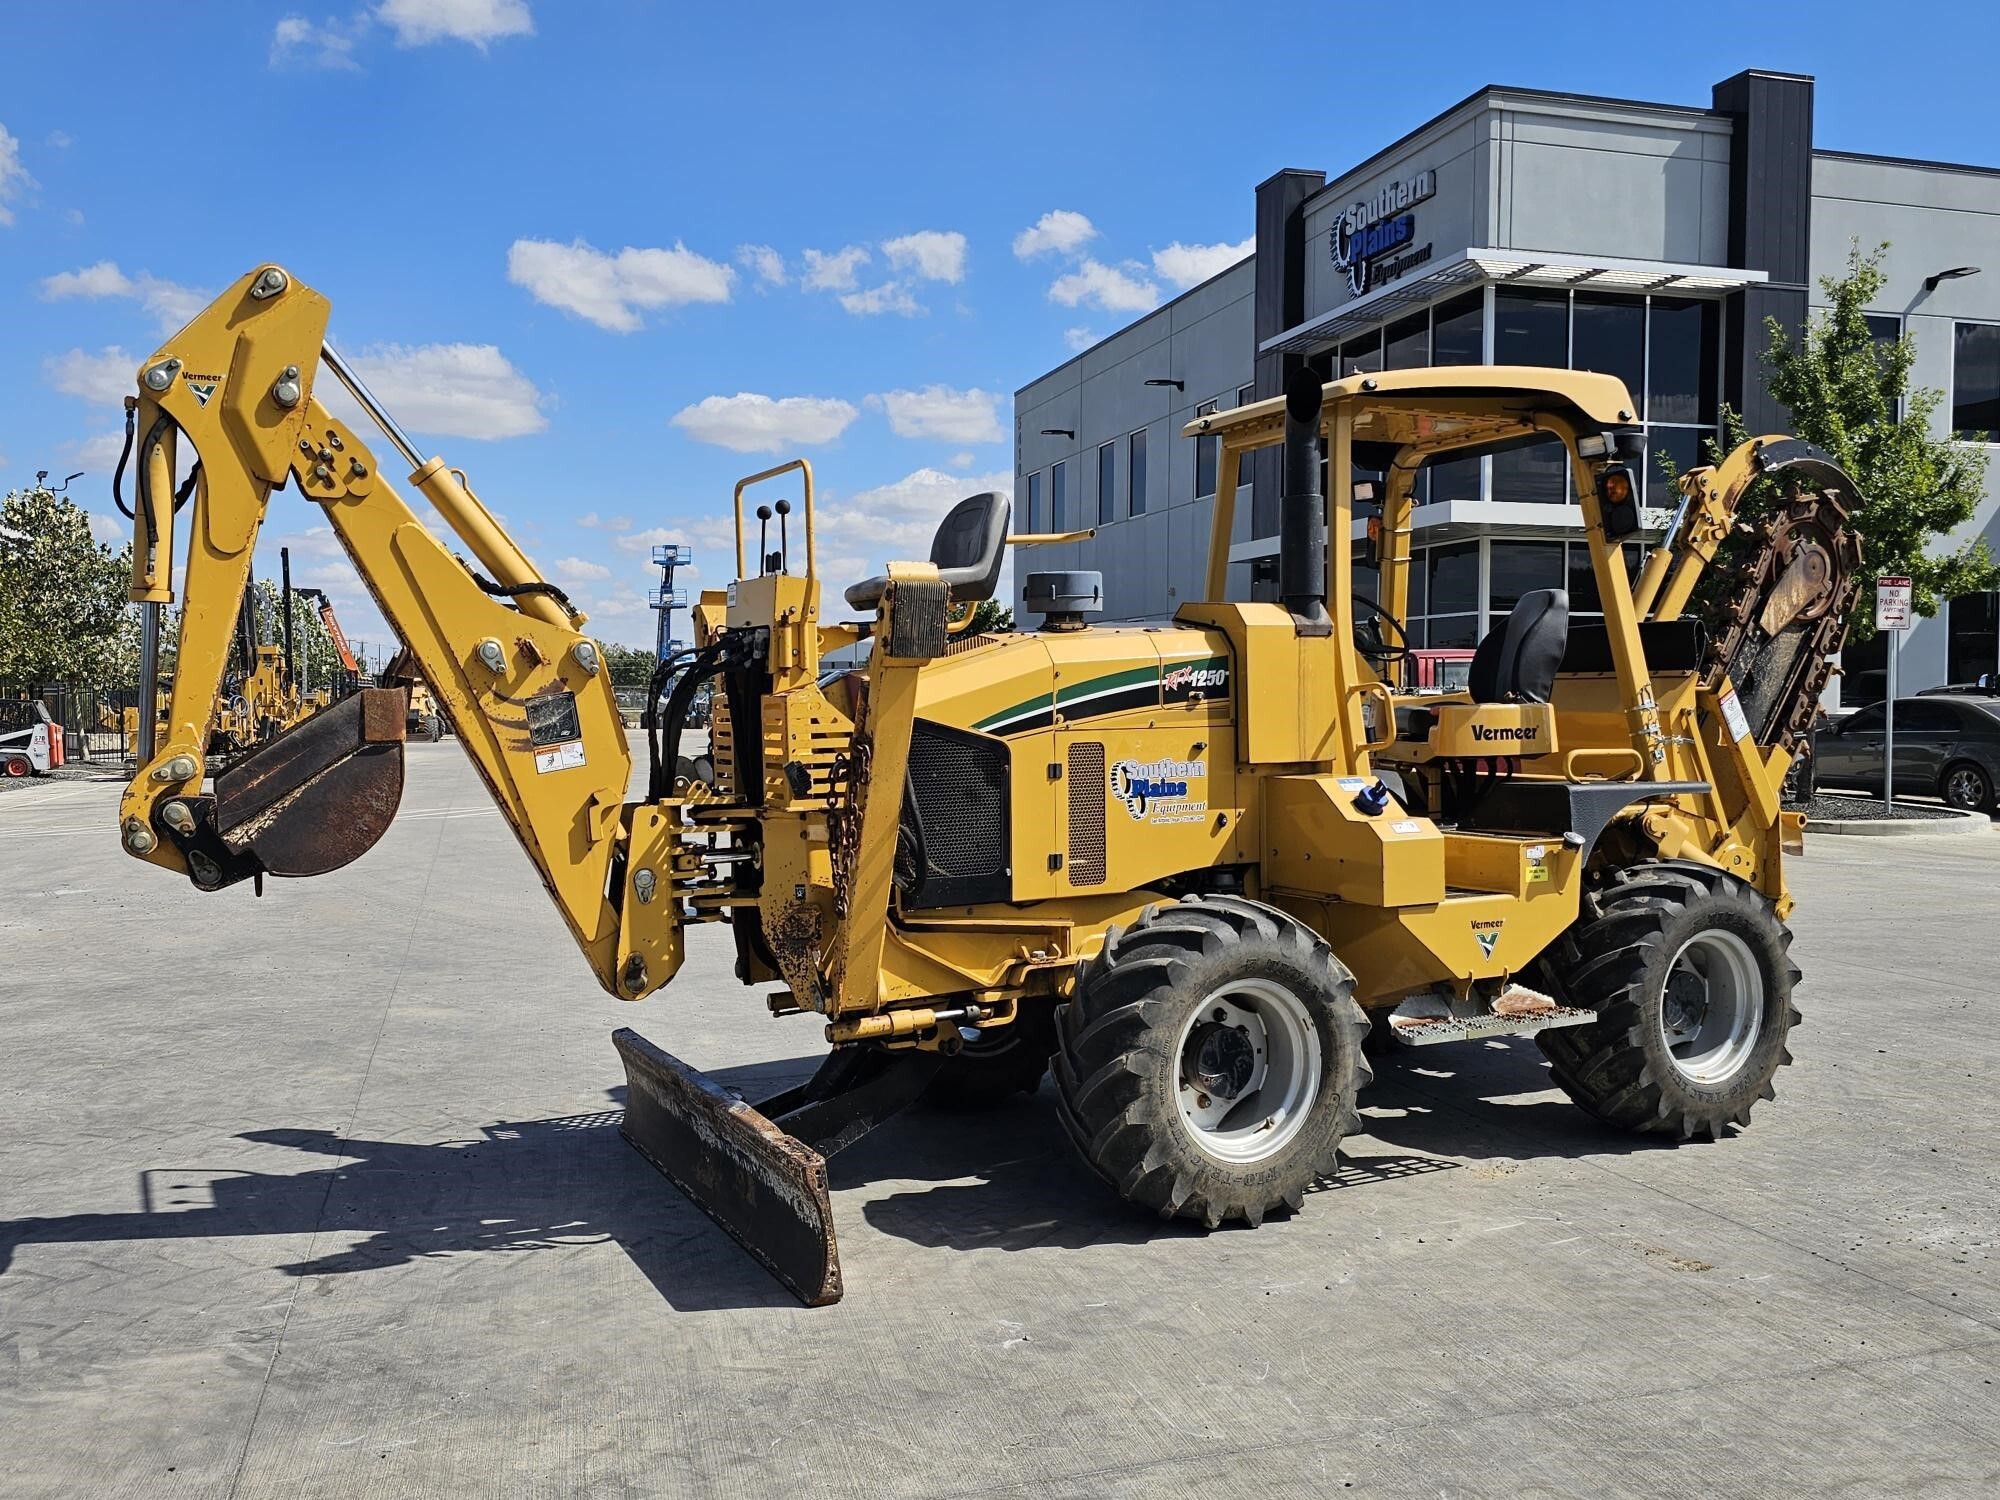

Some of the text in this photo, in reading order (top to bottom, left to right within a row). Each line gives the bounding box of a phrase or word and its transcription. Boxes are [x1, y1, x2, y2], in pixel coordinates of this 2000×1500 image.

[1346, 170, 1431, 235] Southern
[1350, 217, 1410, 263] Plains
[1372, 243, 1432, 285] Equipment
[182, 372, 222, 381] Vermeer
[1880, 599, 1909, 607] PARKING
[1165, 666, 1225, 691] RTX 1250
[1471, 725, 1537, 741] Vermeer
[1126, 759, 1206, 779] Southern
[1130, 778, 1188, 798] Plains
[1152, 802, 1206, 816] Equipment
[1471, 920, 1504, 930] Vermeer
